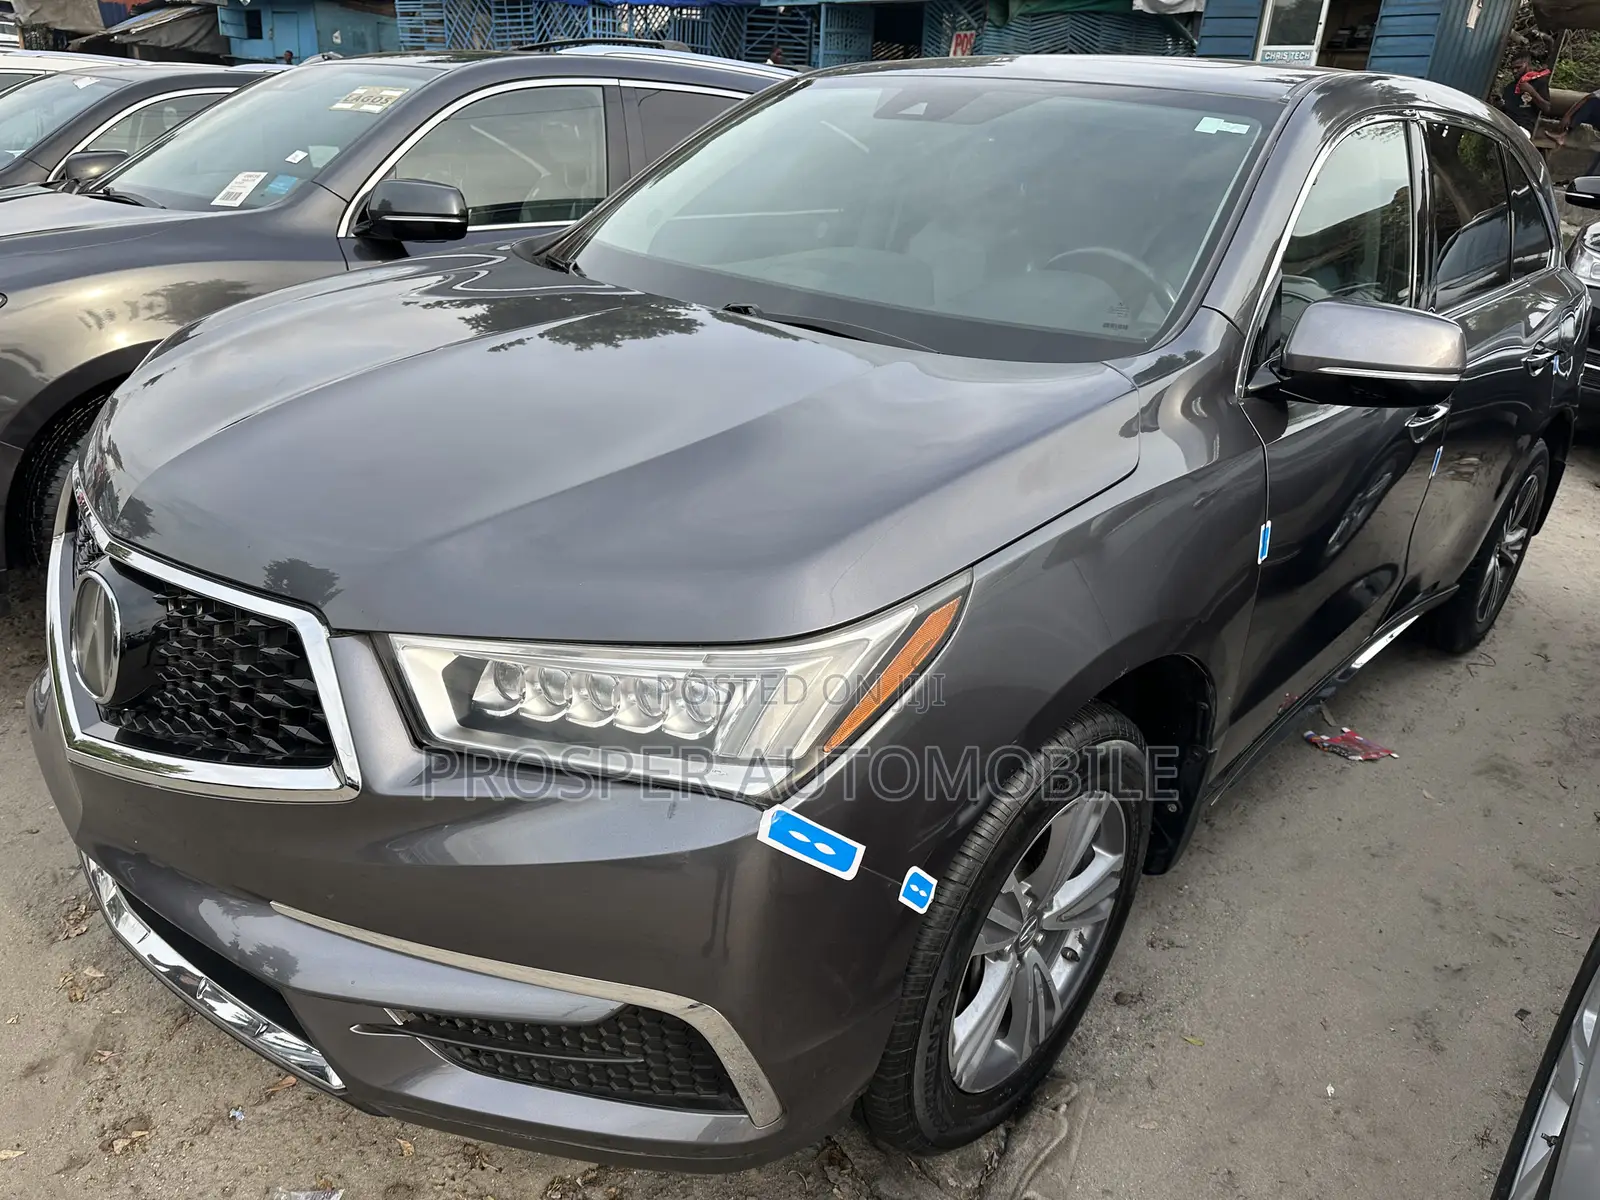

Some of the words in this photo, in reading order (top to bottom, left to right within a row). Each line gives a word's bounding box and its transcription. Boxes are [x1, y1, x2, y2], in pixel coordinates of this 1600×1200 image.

[1264, 51, 1288, 60] CHRIS
[1290, 51, 1310, 60] TECH
[343, 95, 393, 104] LAGOS
